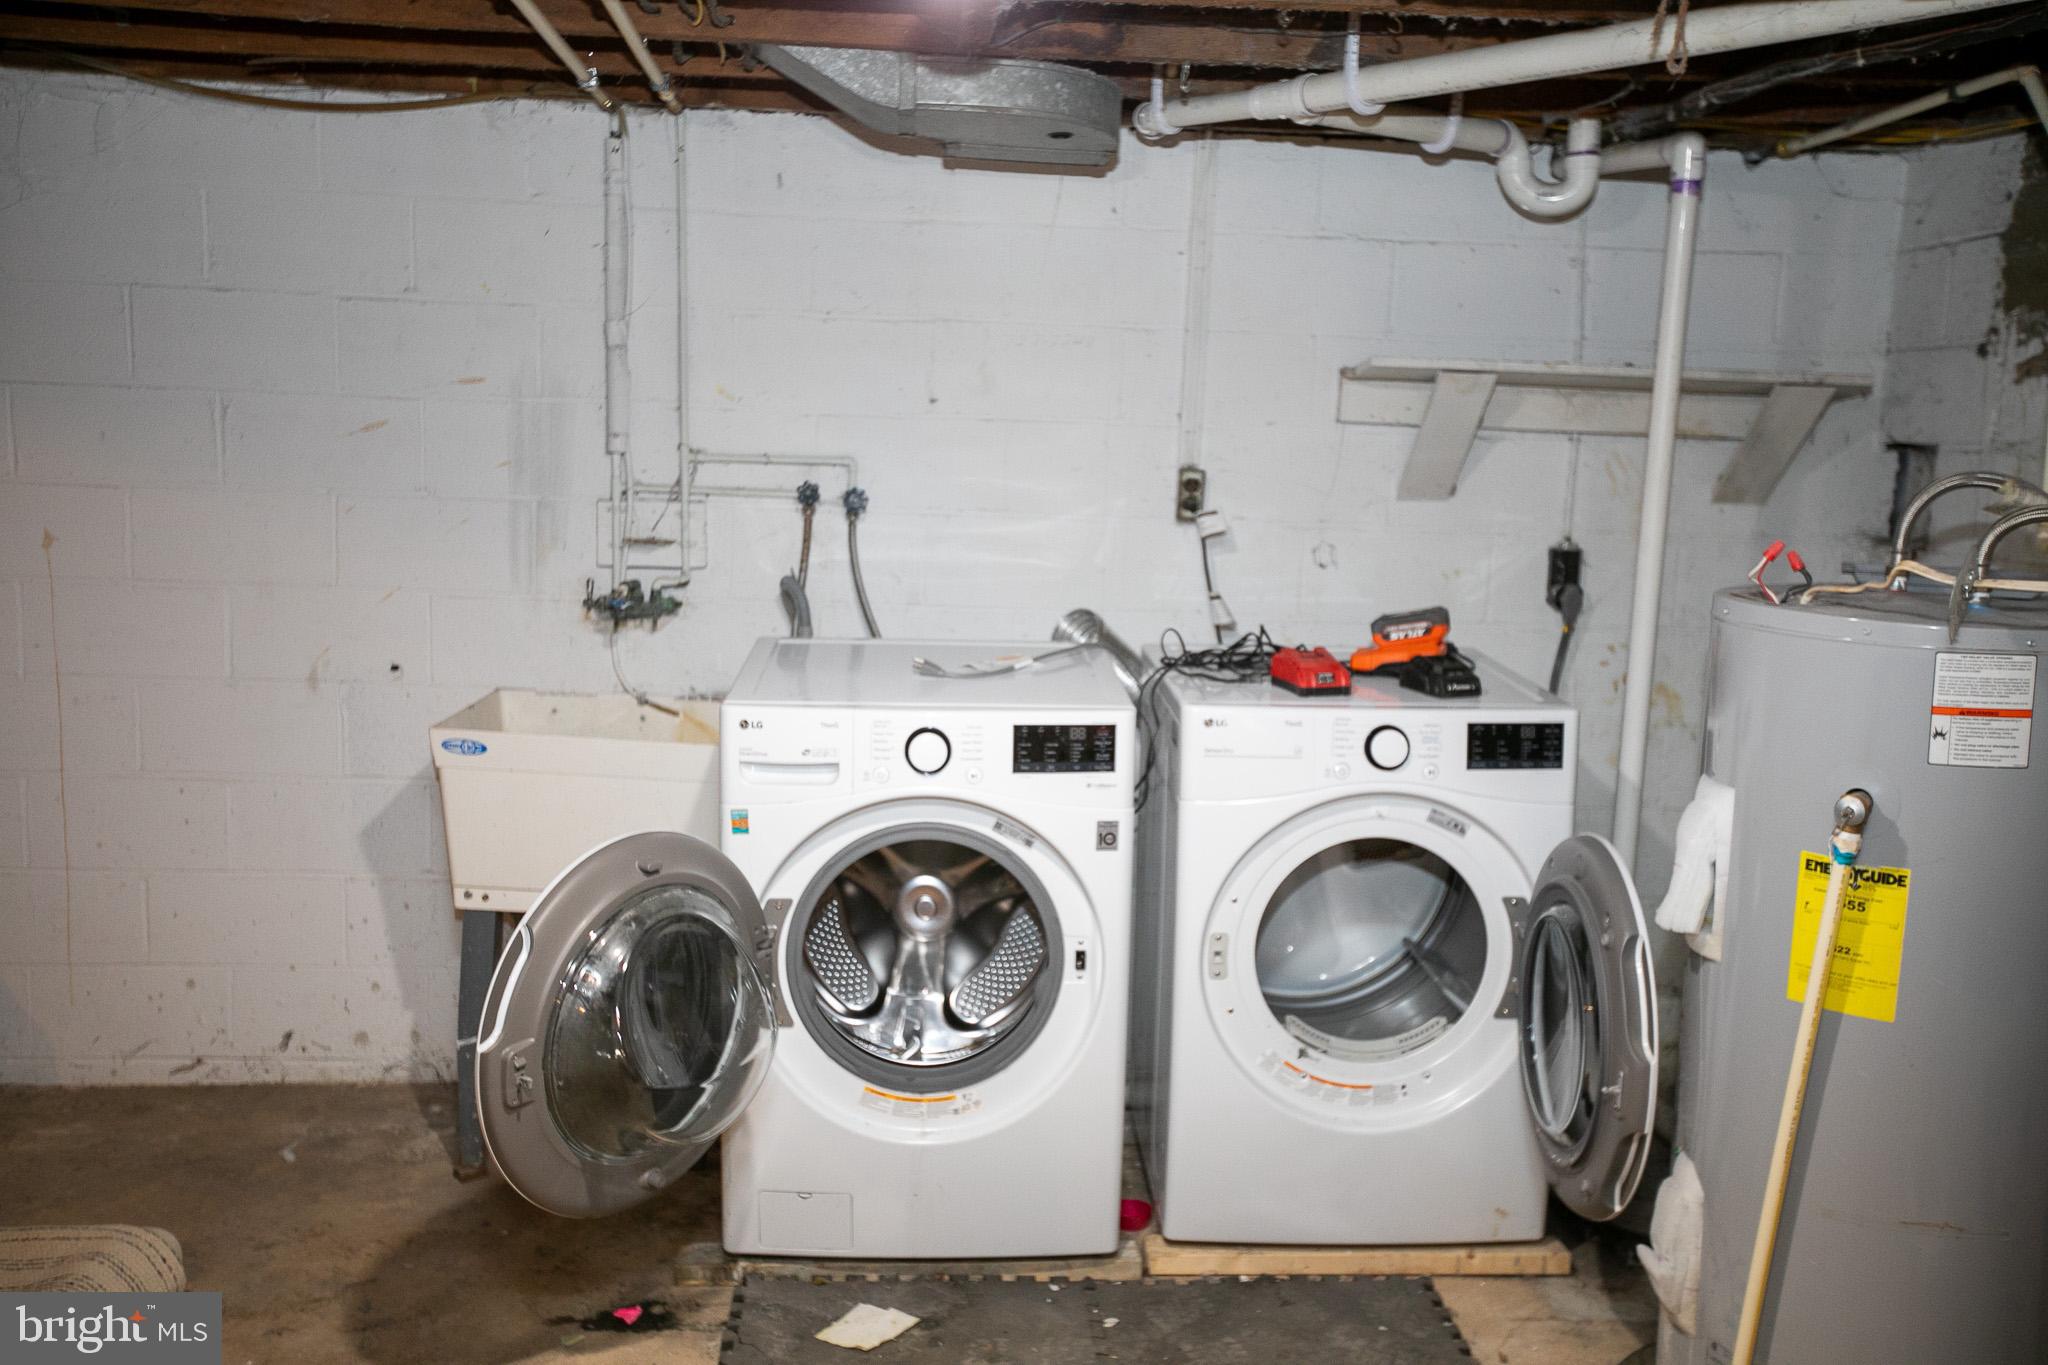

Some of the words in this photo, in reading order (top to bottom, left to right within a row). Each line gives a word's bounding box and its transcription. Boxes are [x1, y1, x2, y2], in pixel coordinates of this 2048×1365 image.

[751, 720, 763, 729] LG
[1215, 719, 1228, 727] LG
[1805, 858, 1908, 888] ENEYGUIDE
[1843, 900, 1866, 913] 55
